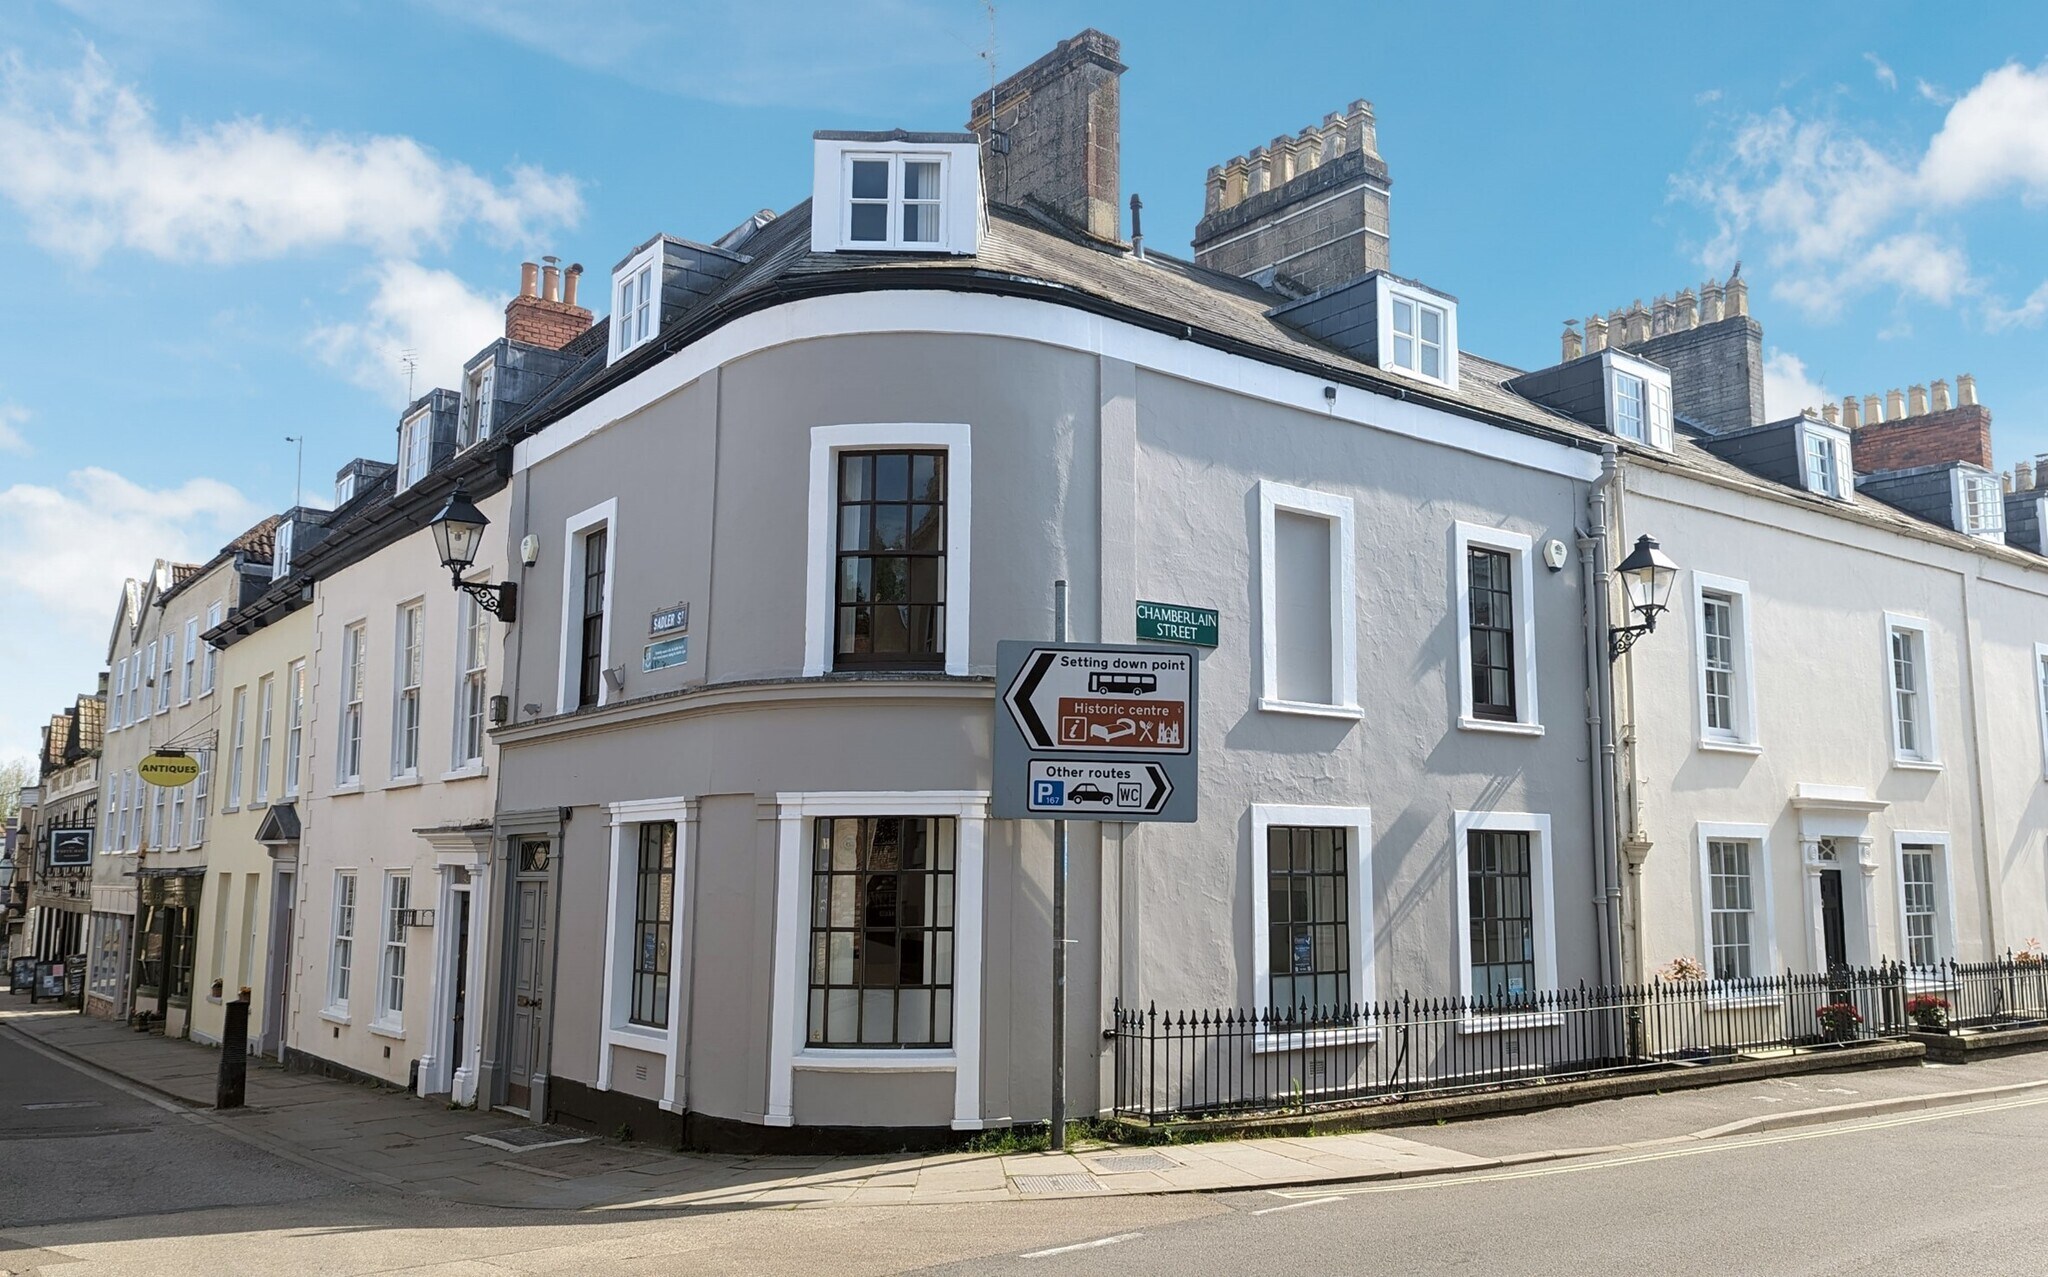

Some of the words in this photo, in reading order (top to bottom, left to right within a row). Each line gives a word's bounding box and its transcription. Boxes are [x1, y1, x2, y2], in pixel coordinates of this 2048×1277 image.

[653, 613, 675, 630] SADLER
[1136, 605, 1217, 627] CHAMBERLAIN
[1156, 622, 1198, 640] STREET
[1060, 656, 1108, 670] Setting
[1113, 658, 1147, 670] down
[1152, 659, 1185, 671] point
[1074, 702, 1125, 715] Historic
[1129, 705, 1170, 716] centre
[141, 764, 197, 774] ANTIQUES
[1046, 766, 1084, 778] Other
[1089, 768, 1131, 779] routes
[1037, 783, 1053, 803] P
[1120, 788, 1139, 802] WC
